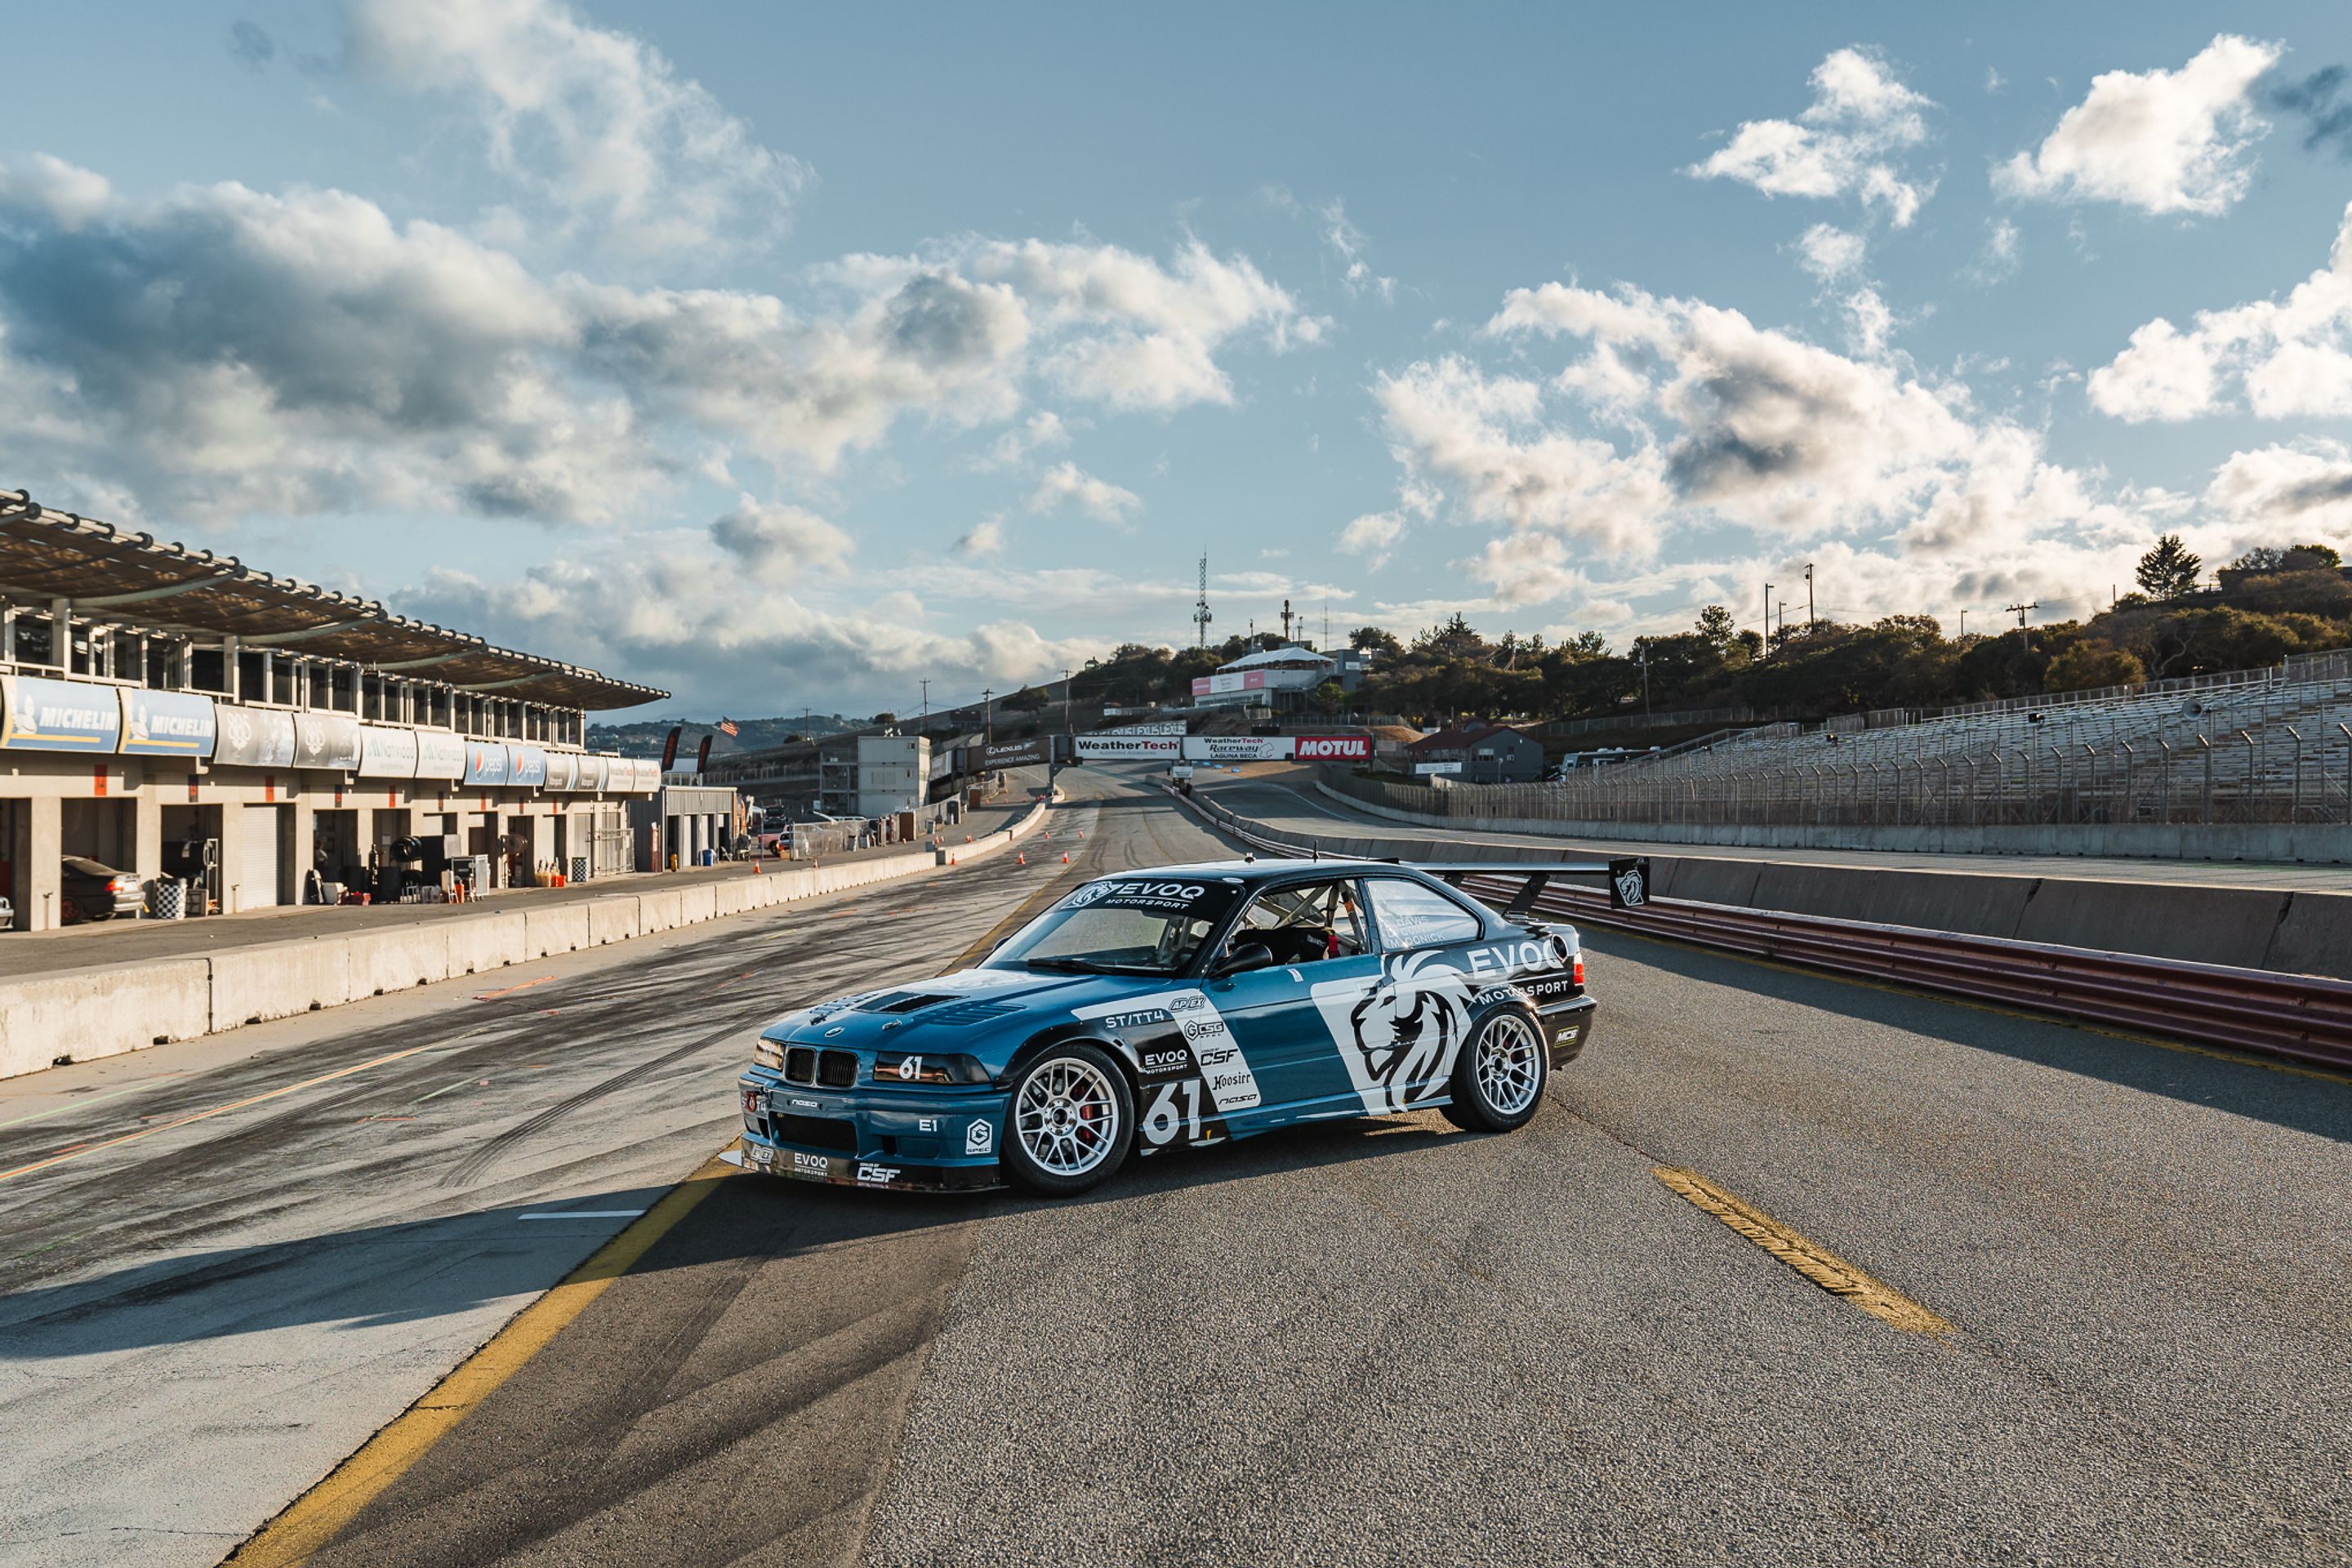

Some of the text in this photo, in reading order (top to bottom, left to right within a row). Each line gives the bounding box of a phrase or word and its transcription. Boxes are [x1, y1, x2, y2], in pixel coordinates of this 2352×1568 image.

[39, 706, 118, 731] MICHELIN
[150, 715, 213, 737] MICHELIN
[996, 744, 1022, 753] LEXUS
[1078, 741, 1178, 750] WeatherTech
[1209, 744, 1259, 753] Raceway
[1299, 741, 1366, 755] MOTUL
[484, 755, 503, 777] pepsi
[525, 756, 541, 777] pepsi
[985, 753, 1040, 766] EXPERIENCE AMAZING
[1117, 883, 1205, 899] EVOQ
[1105, 898, 1189, 909] MOTORSPORT
[1478, 981, 1568, 1005] MOTSPORT
[1105, 1010, 1165, 1029] ST/TT4
[1199, 1022, 1223, 1034] CSG
[1556, 1029, 1579, 1042] MCS
[1145, 1049, 1187, 1066] EVOQ
[1200, 1049, 1238, 1067] CSF
[899, 1056, 922, 1080] 61
[1146, 1064, 1187, 1075] MOTORSPORT
[1212, 1071, 1250, 1090] Hoosier
[1143, 1079, 1200, 1144] 61
[919, 1119, 938, 1132] E1
[794, 1152, 828, 1169] EVOQ
[794, 1167, 828, 1177] MOTORSPORT
[858, 1167, 901, 1183] CSF
